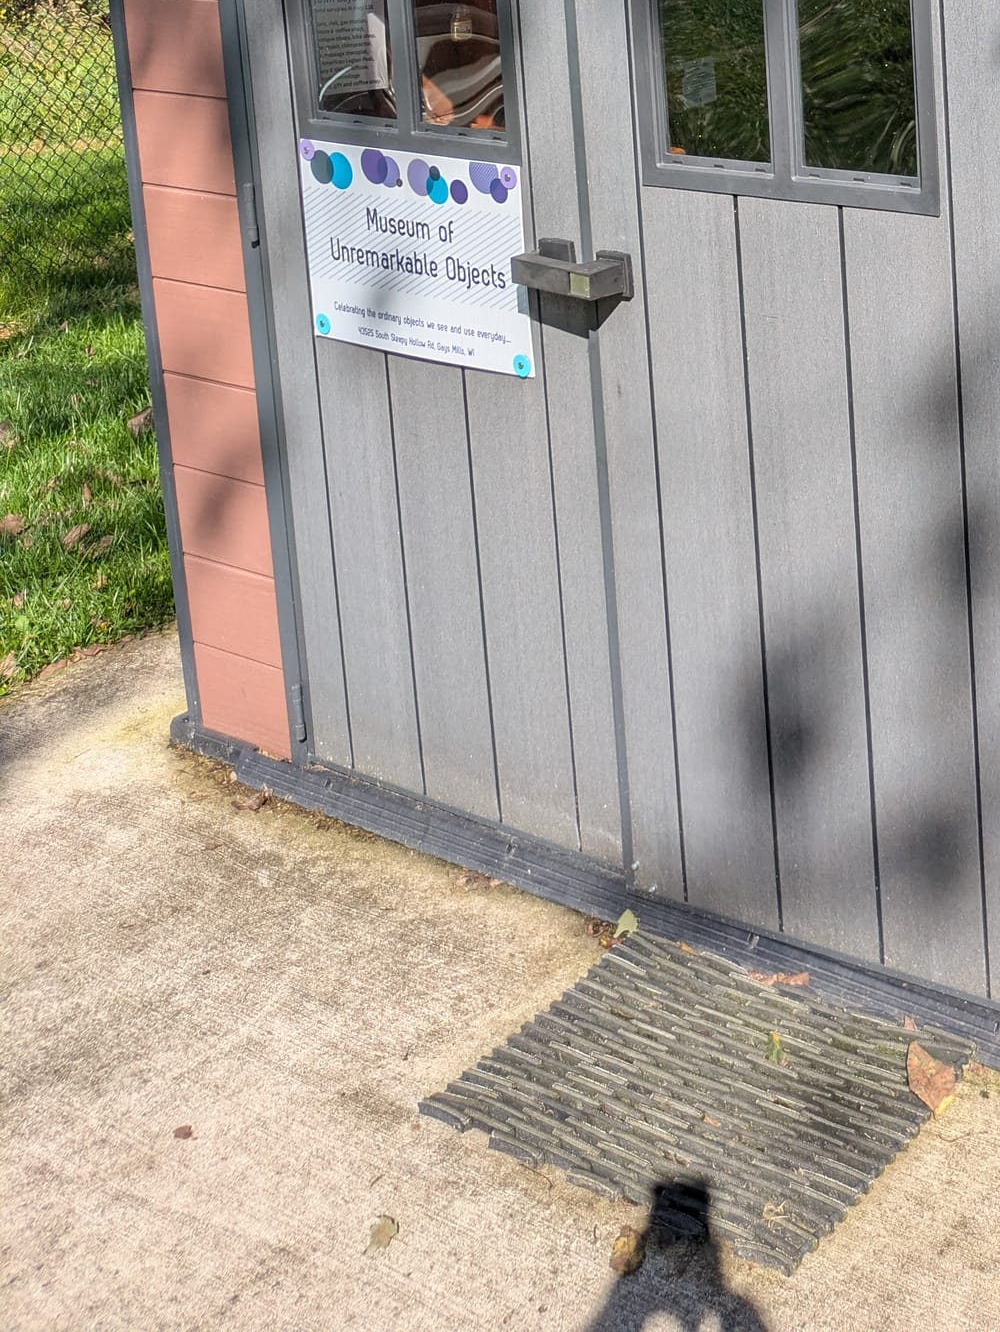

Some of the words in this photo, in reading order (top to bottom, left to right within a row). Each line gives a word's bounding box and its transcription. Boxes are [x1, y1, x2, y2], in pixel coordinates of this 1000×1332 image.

[366, 207, 430, 240] Museum
[438, 220, 454, 243] of
[330, 236, 438, 278] Unremarkable
[445, 256, 506, 289] Objects
[334, 301, 365, 318] Celebrating
[366, 307, 376, 318] the
[378, 311, 402, 325] ordinary
[403, 315, 424, 328] objects
[426, 321, 435, 329] we
[437, 323, 448, 332] see
[450, 324, 462, 334] and
[463, 328, 475, 337] use
[375, 329, 390, 341] South
[391, 333, 408, 347] Sleepy
[408, 336, 426, 348] Hollow
[437, 341, 451, 354] Gays
[467, 347, 475, 357] WI
